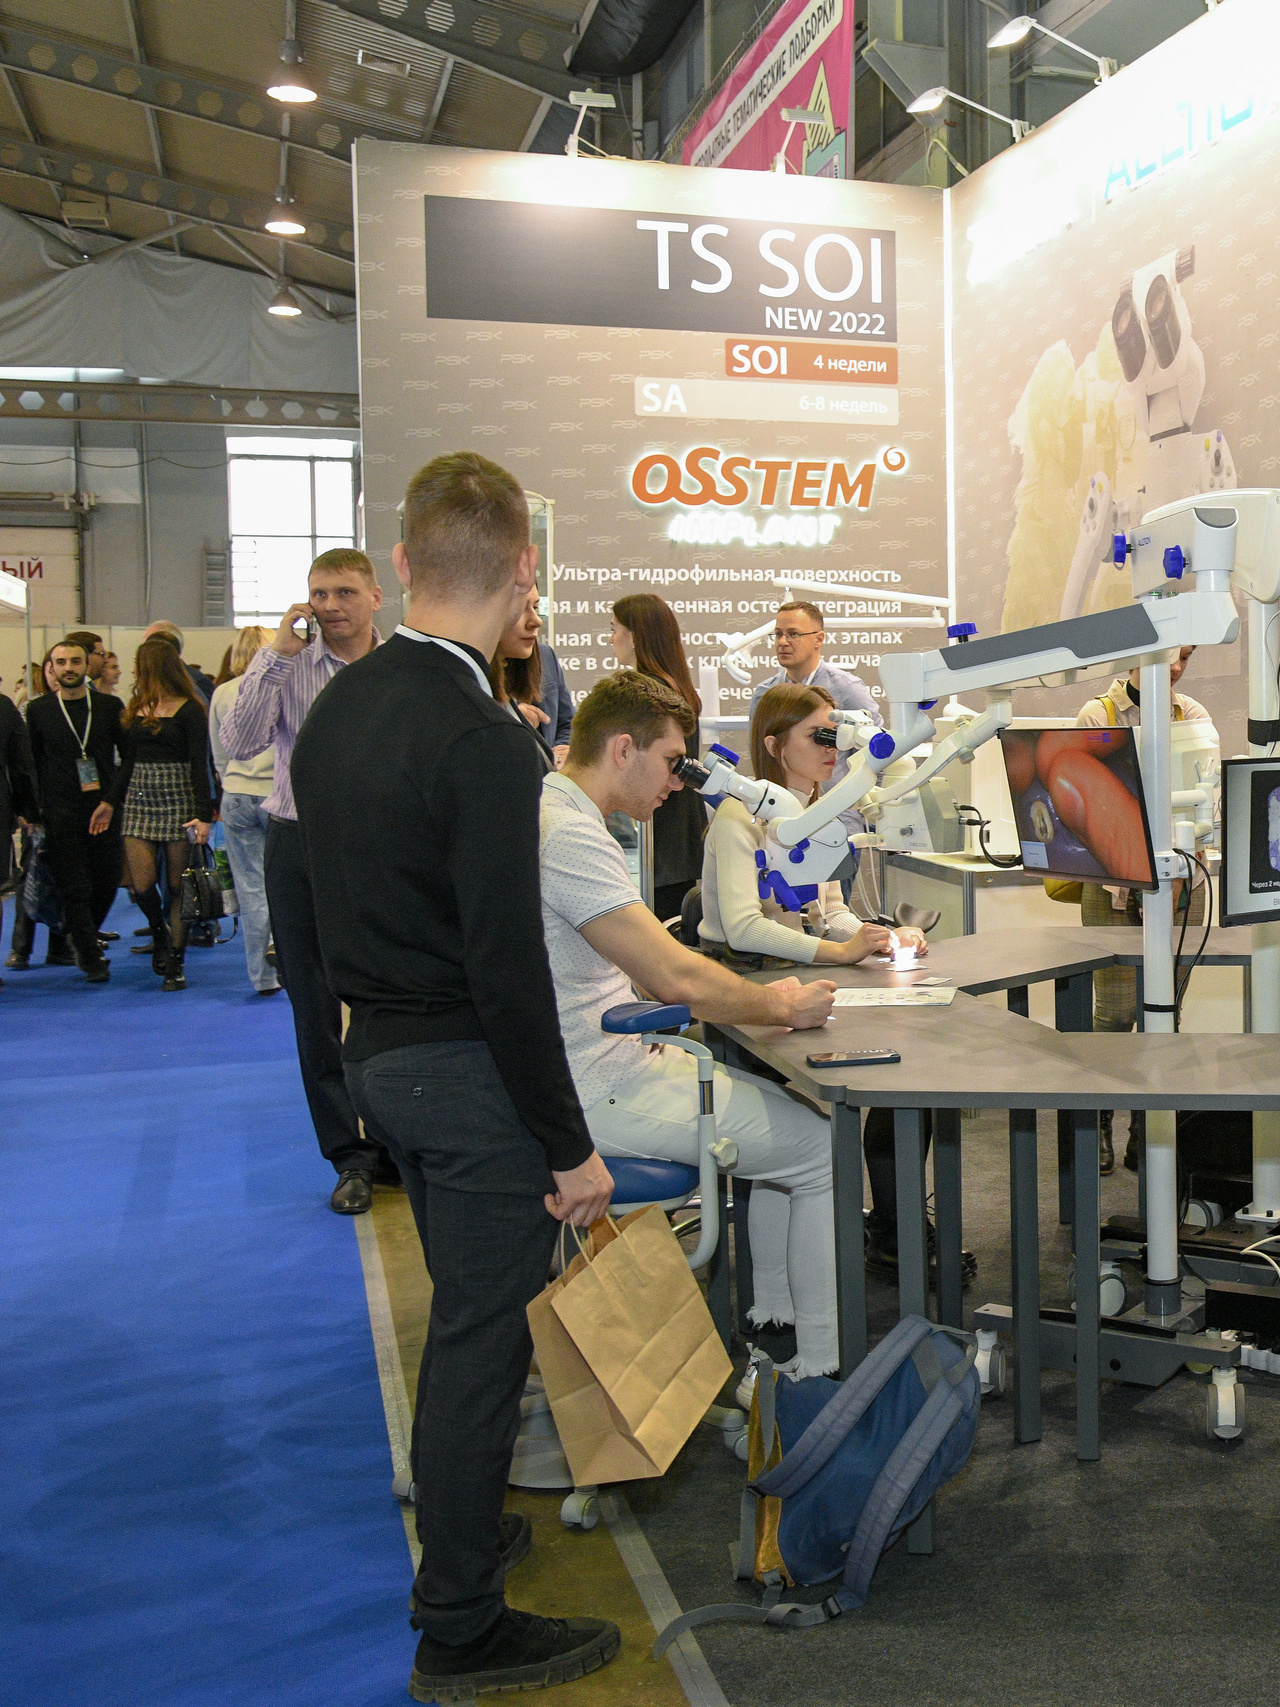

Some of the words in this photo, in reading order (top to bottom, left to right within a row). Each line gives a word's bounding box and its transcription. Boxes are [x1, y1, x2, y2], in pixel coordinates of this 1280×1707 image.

[732, 49, 787, 136] ТЕМАТИЧЕСКИЕ
[789, 0, 836, 69] ПОДБОРКИ
[636, 219, 733, 294] TS
[758, 228, 882, 304] SOI
[765, 306, 822, 331] NEW
[828, 310, 886, 335] 2022
[732, 344, 788, 375] SOI
[813, 354, 824, 370] 4
[828, 357, 887, 374] недели
[642, 382, 688, 413] SA
[799, 395, 825, 411] 6-8
[829, 398, 888, 415] недель
[552, 563, 775, 585] Ультра-гидрофильная
[576, 601, 590, 614] и
[841, 631, 903, 645] этапах
[585, 657, 598, 671] в
